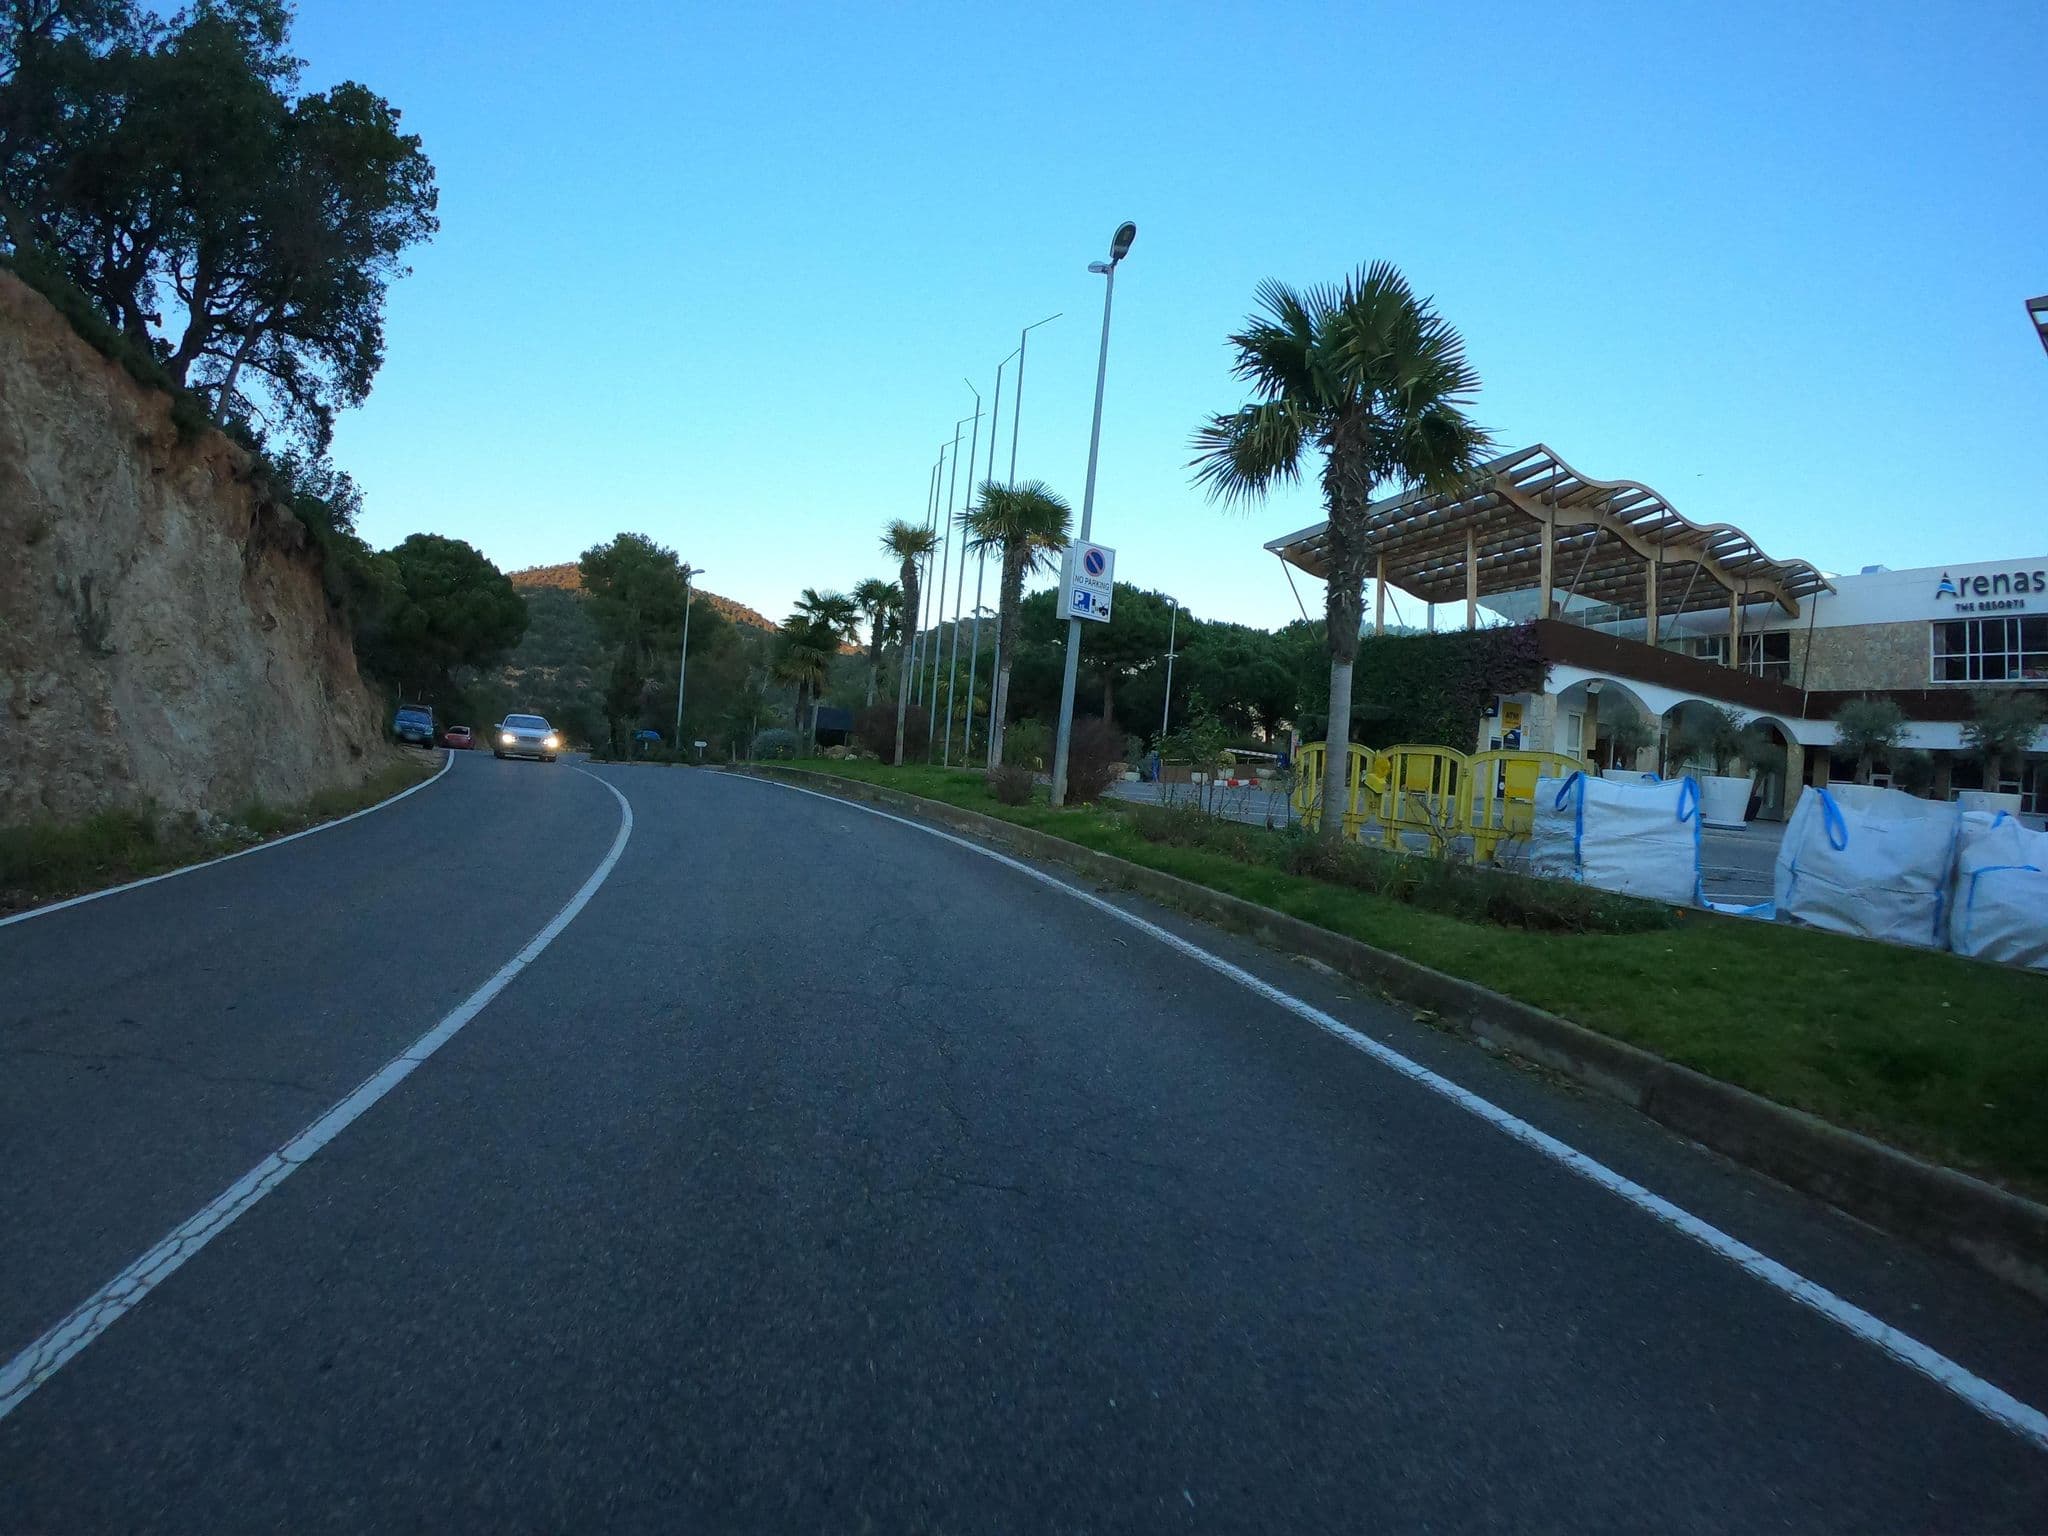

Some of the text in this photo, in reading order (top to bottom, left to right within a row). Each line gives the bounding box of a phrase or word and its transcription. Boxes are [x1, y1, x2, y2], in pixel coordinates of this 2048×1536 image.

[1074, 576, 1110, 591] NO PARKING
[1935, 571, 2046, 600] Arenas
[1955, 602, 1975, 612] THE
